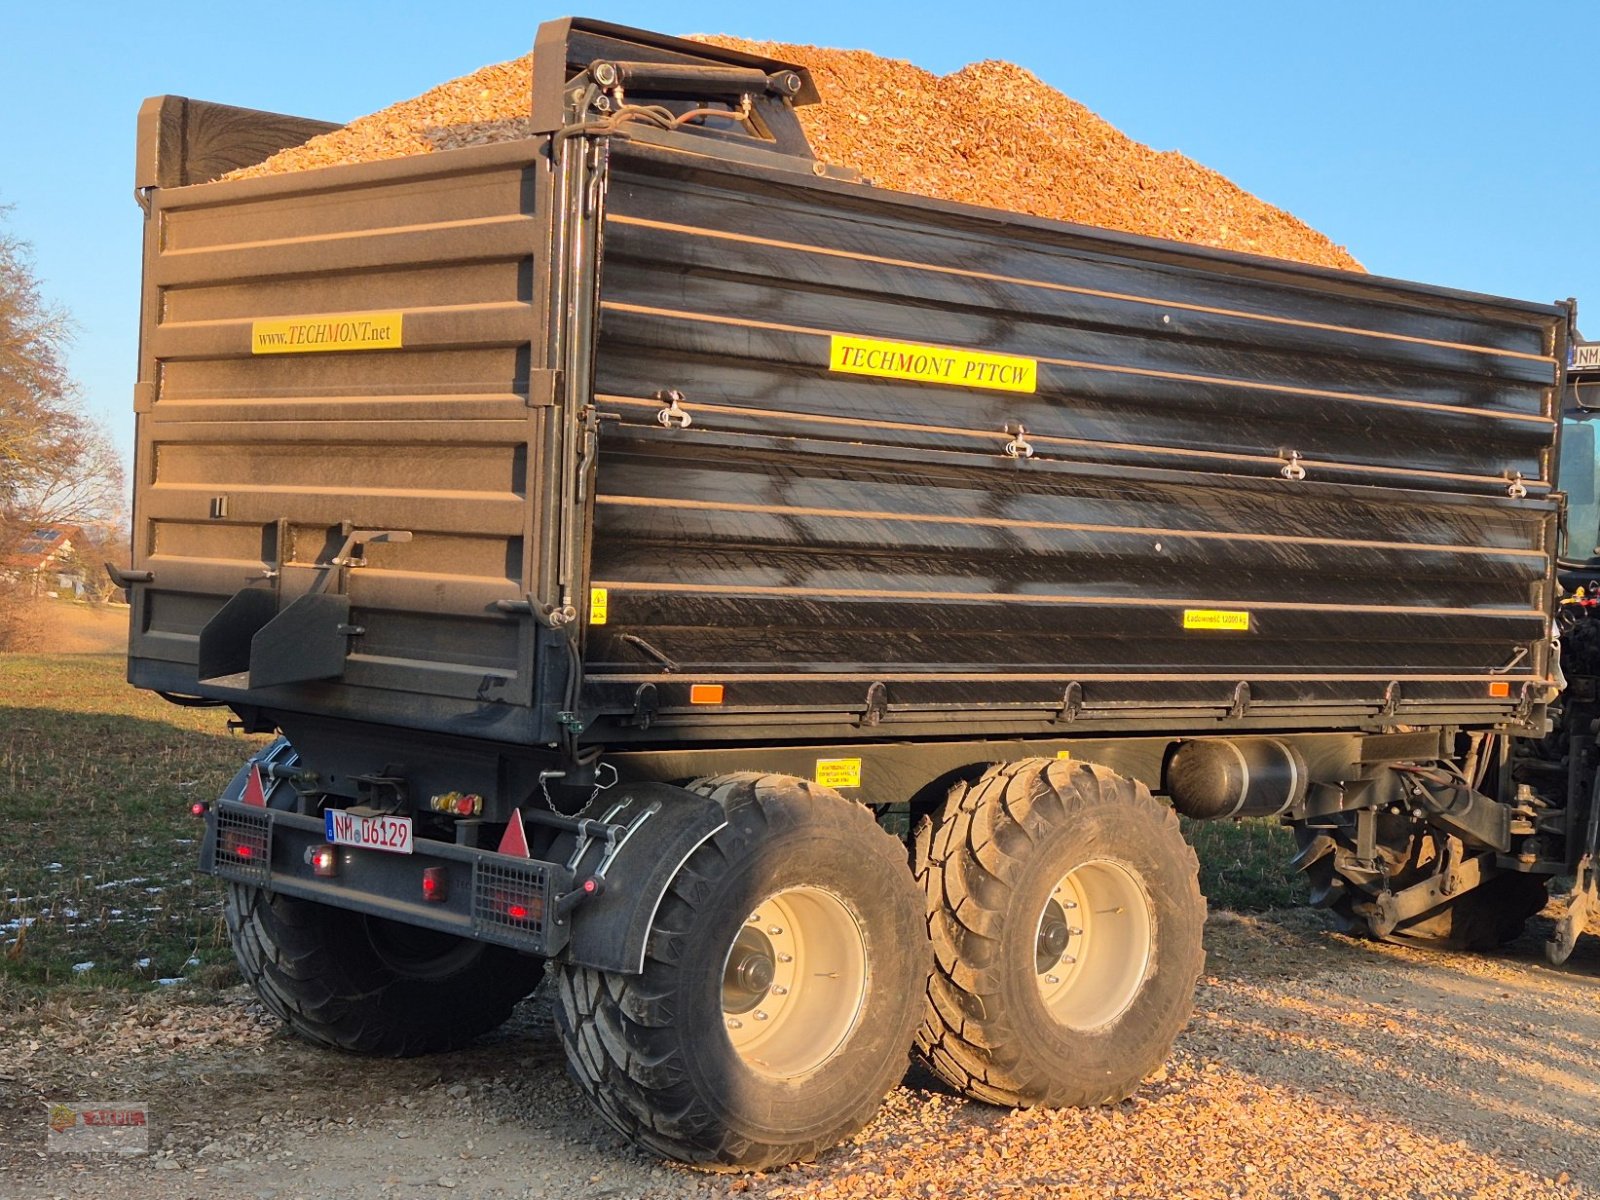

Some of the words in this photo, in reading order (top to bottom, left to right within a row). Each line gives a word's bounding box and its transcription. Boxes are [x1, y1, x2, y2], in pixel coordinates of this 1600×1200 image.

[258, 321, 391, 347] www.TECHMONT.net
[841, 346, 956, 377] TECHMONT
[963, 360, 1030, 385] PTTCW
